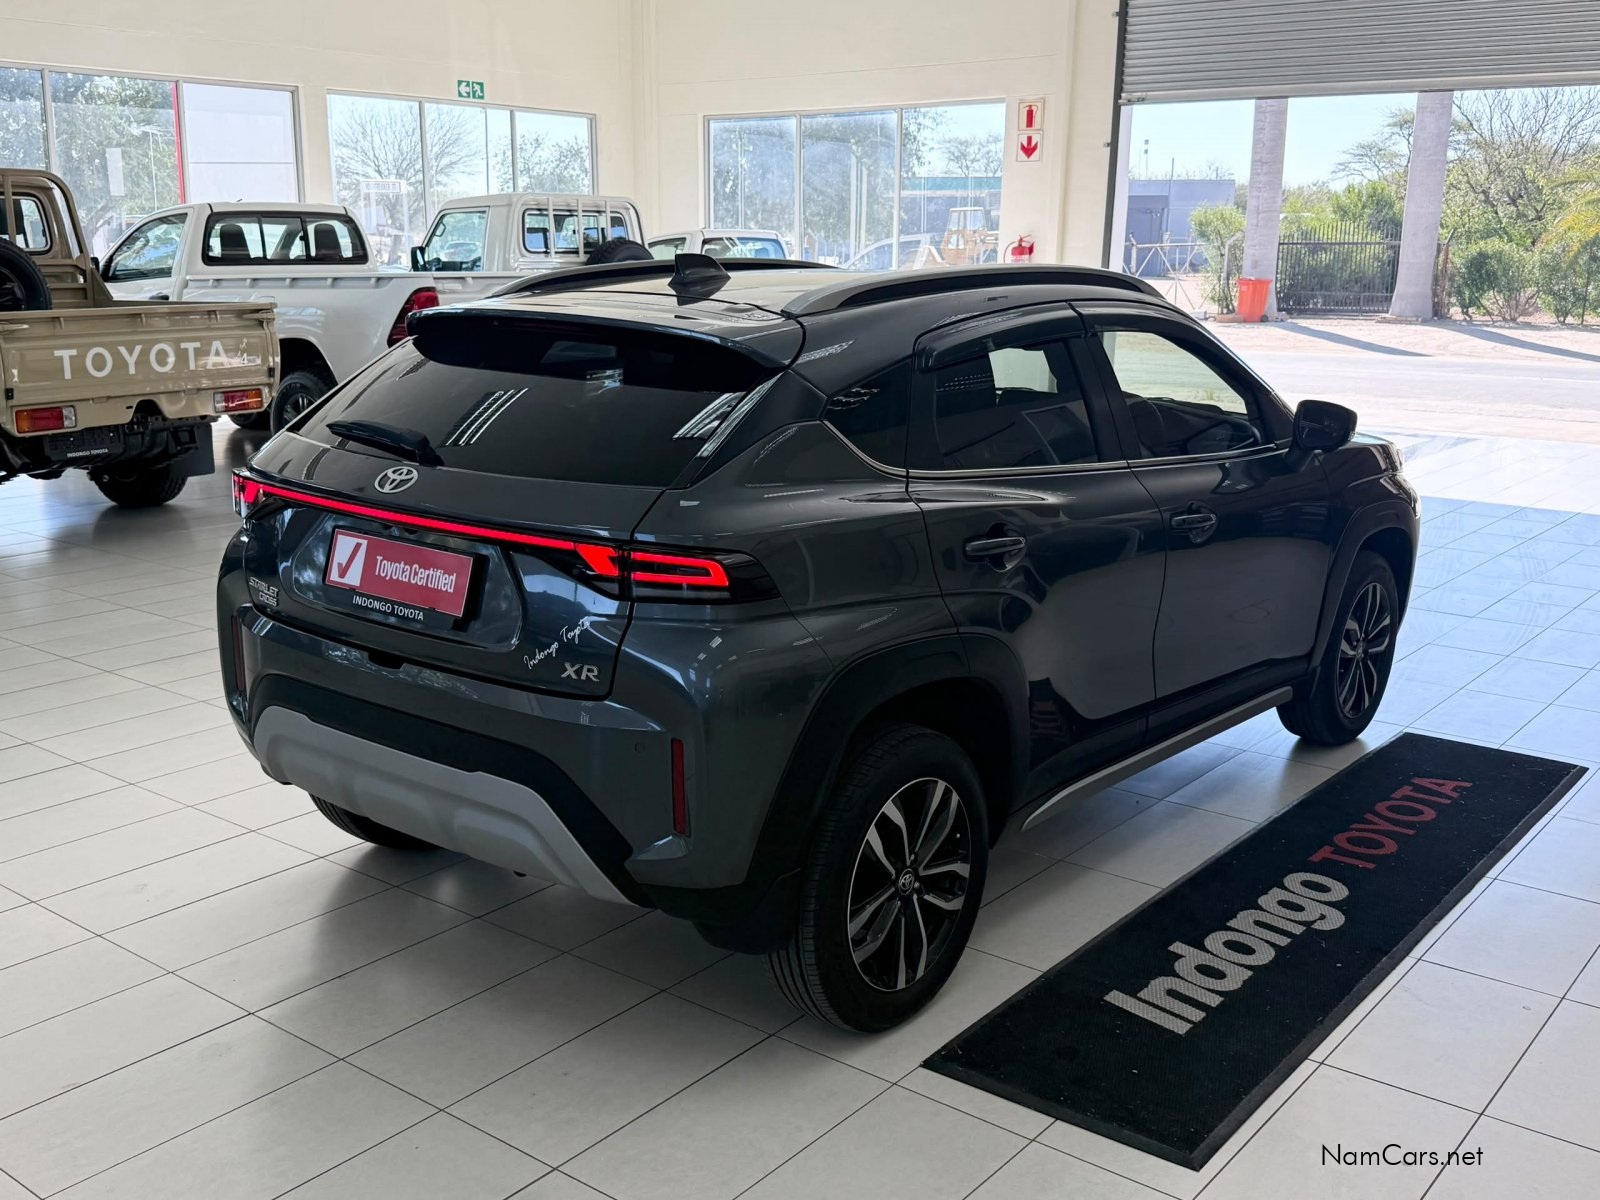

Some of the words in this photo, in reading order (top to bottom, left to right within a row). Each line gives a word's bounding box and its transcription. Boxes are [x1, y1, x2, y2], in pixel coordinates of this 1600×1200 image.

[53, 340, 229, 380] TOYOTA
[67, 451, 90, 459] INDONGO
[90, 448, 109, 456] TOYOTA
[249, 576, 279, 598] STARLET
[375, 555, 410, 582] Toyota
[410, 564, 457, 593] Certified
[259, 591, 278, 607] CROSS
[352, 595, 392, 613] INDONGO
[393, 605, 424, 621] TOYOTA
[523, 641, 559, 670] Indongo
[559, 618, 591, 645] Toyota
[560, 662, 601, 682] XR
[1103, 872, 1350, 1037] Indongo
[1307, 777, 1474, 869] TOYOTA
